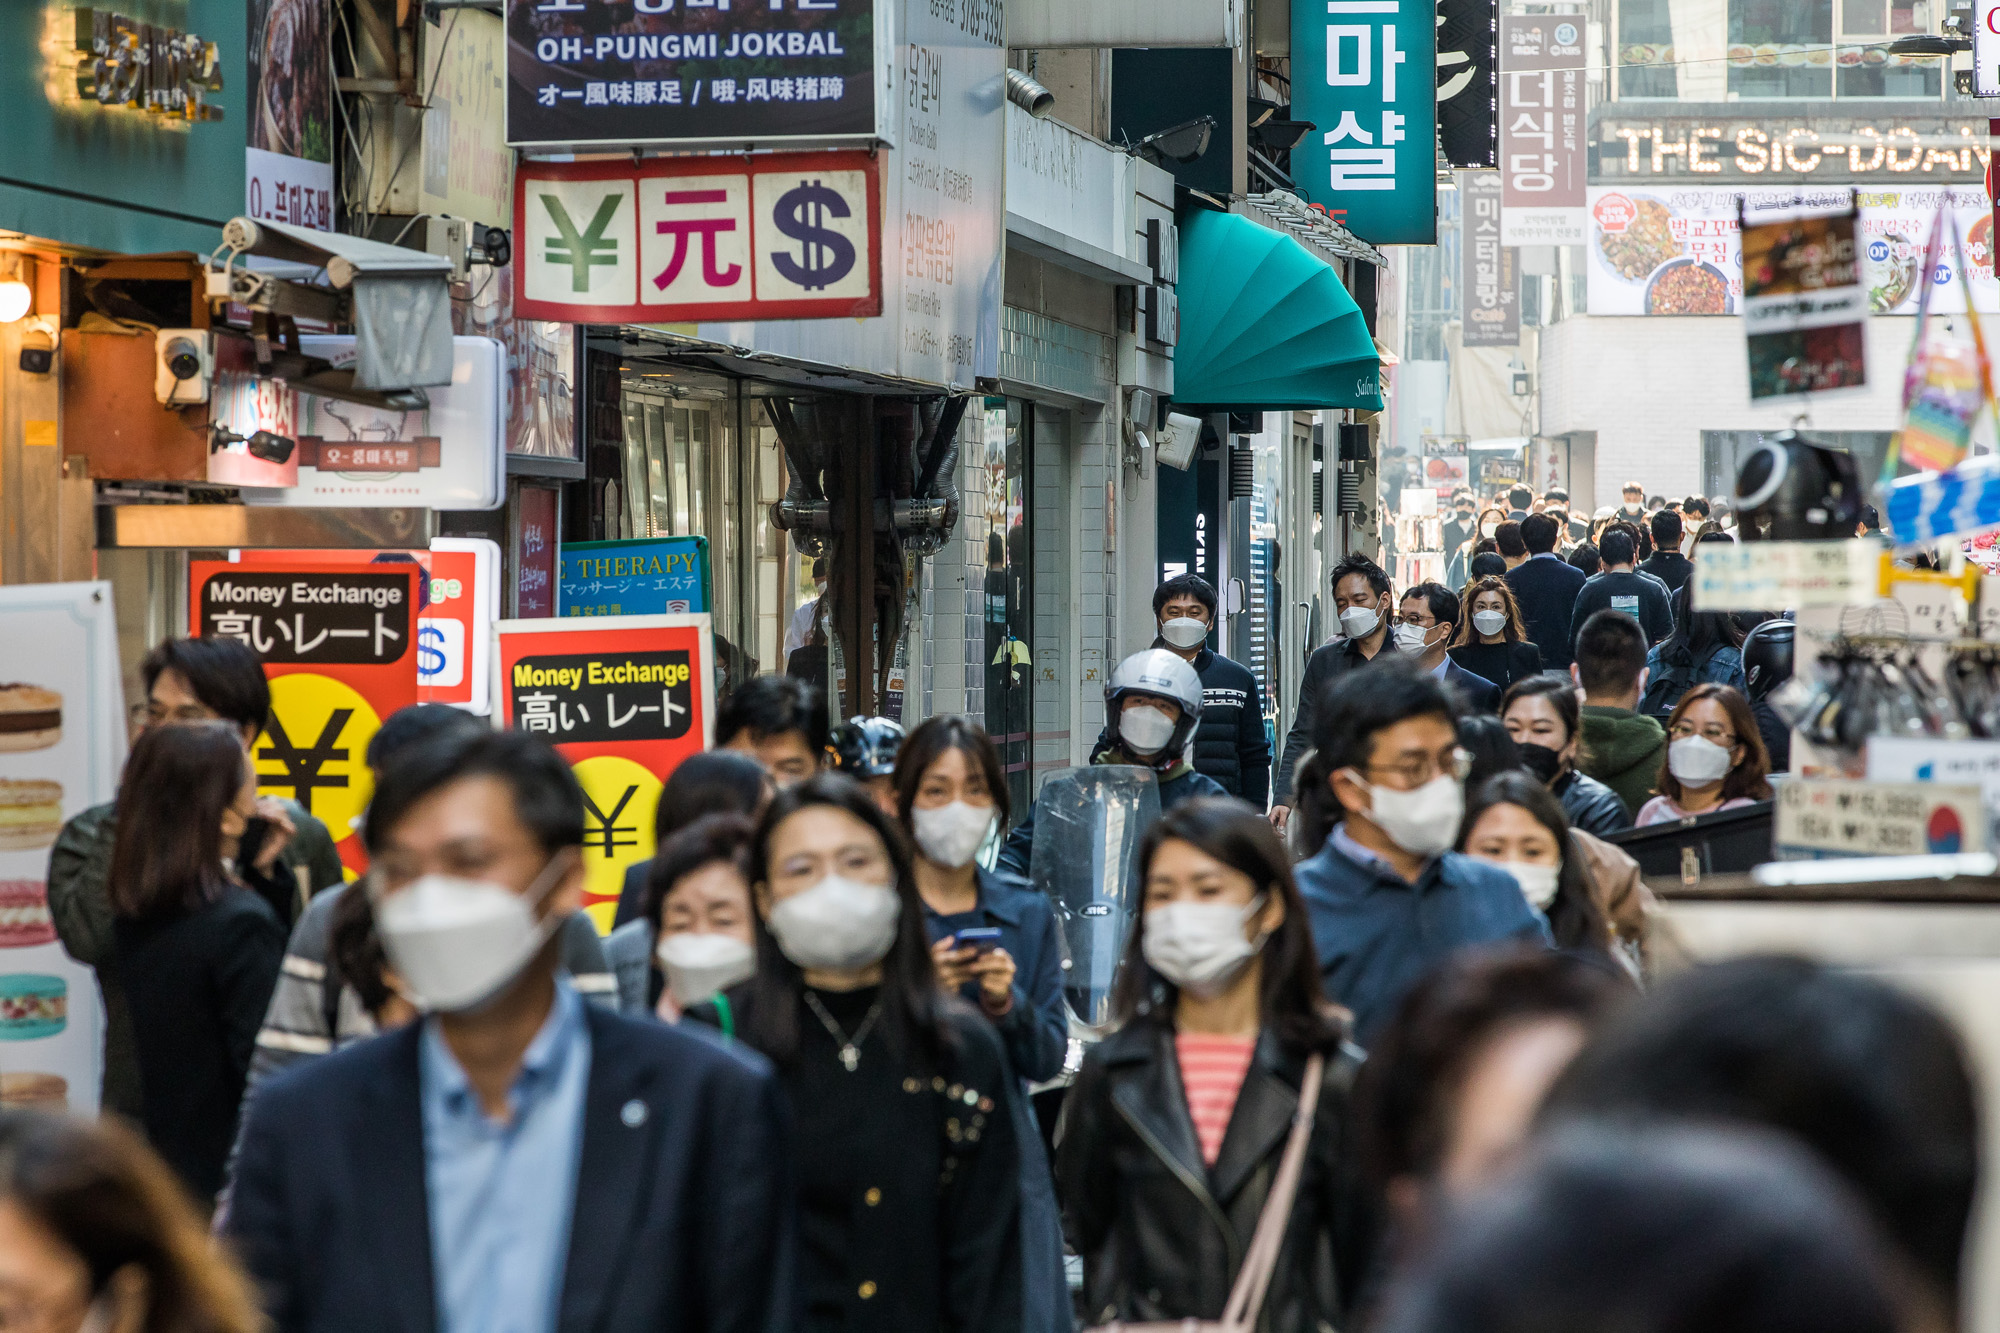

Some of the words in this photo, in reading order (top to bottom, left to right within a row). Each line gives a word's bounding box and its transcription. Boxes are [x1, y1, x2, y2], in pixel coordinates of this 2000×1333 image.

[537, 35, 716, 61] OH-PUNGMI
[724, 31, 843, 57] JOKBAL
[1509, 70, 1559, 192] 더식당
[1616, 126, 1722, 173] THE
[652, 189, 742, 291] 元
[770, 179, 856, 291] $
[1692, 241, 1728, 264] 무침
[1196, 512, 1206, 574] SKIN
[577, 552, 697, 579] THERAPY
[210, 581, 287, 608] Money
[291, 582, 402, 609] Exchange
[210, 611, 400, 657] 高いレート
[513, 664, 583, 691] Money
[587, 660, 690, 687] Exchange
